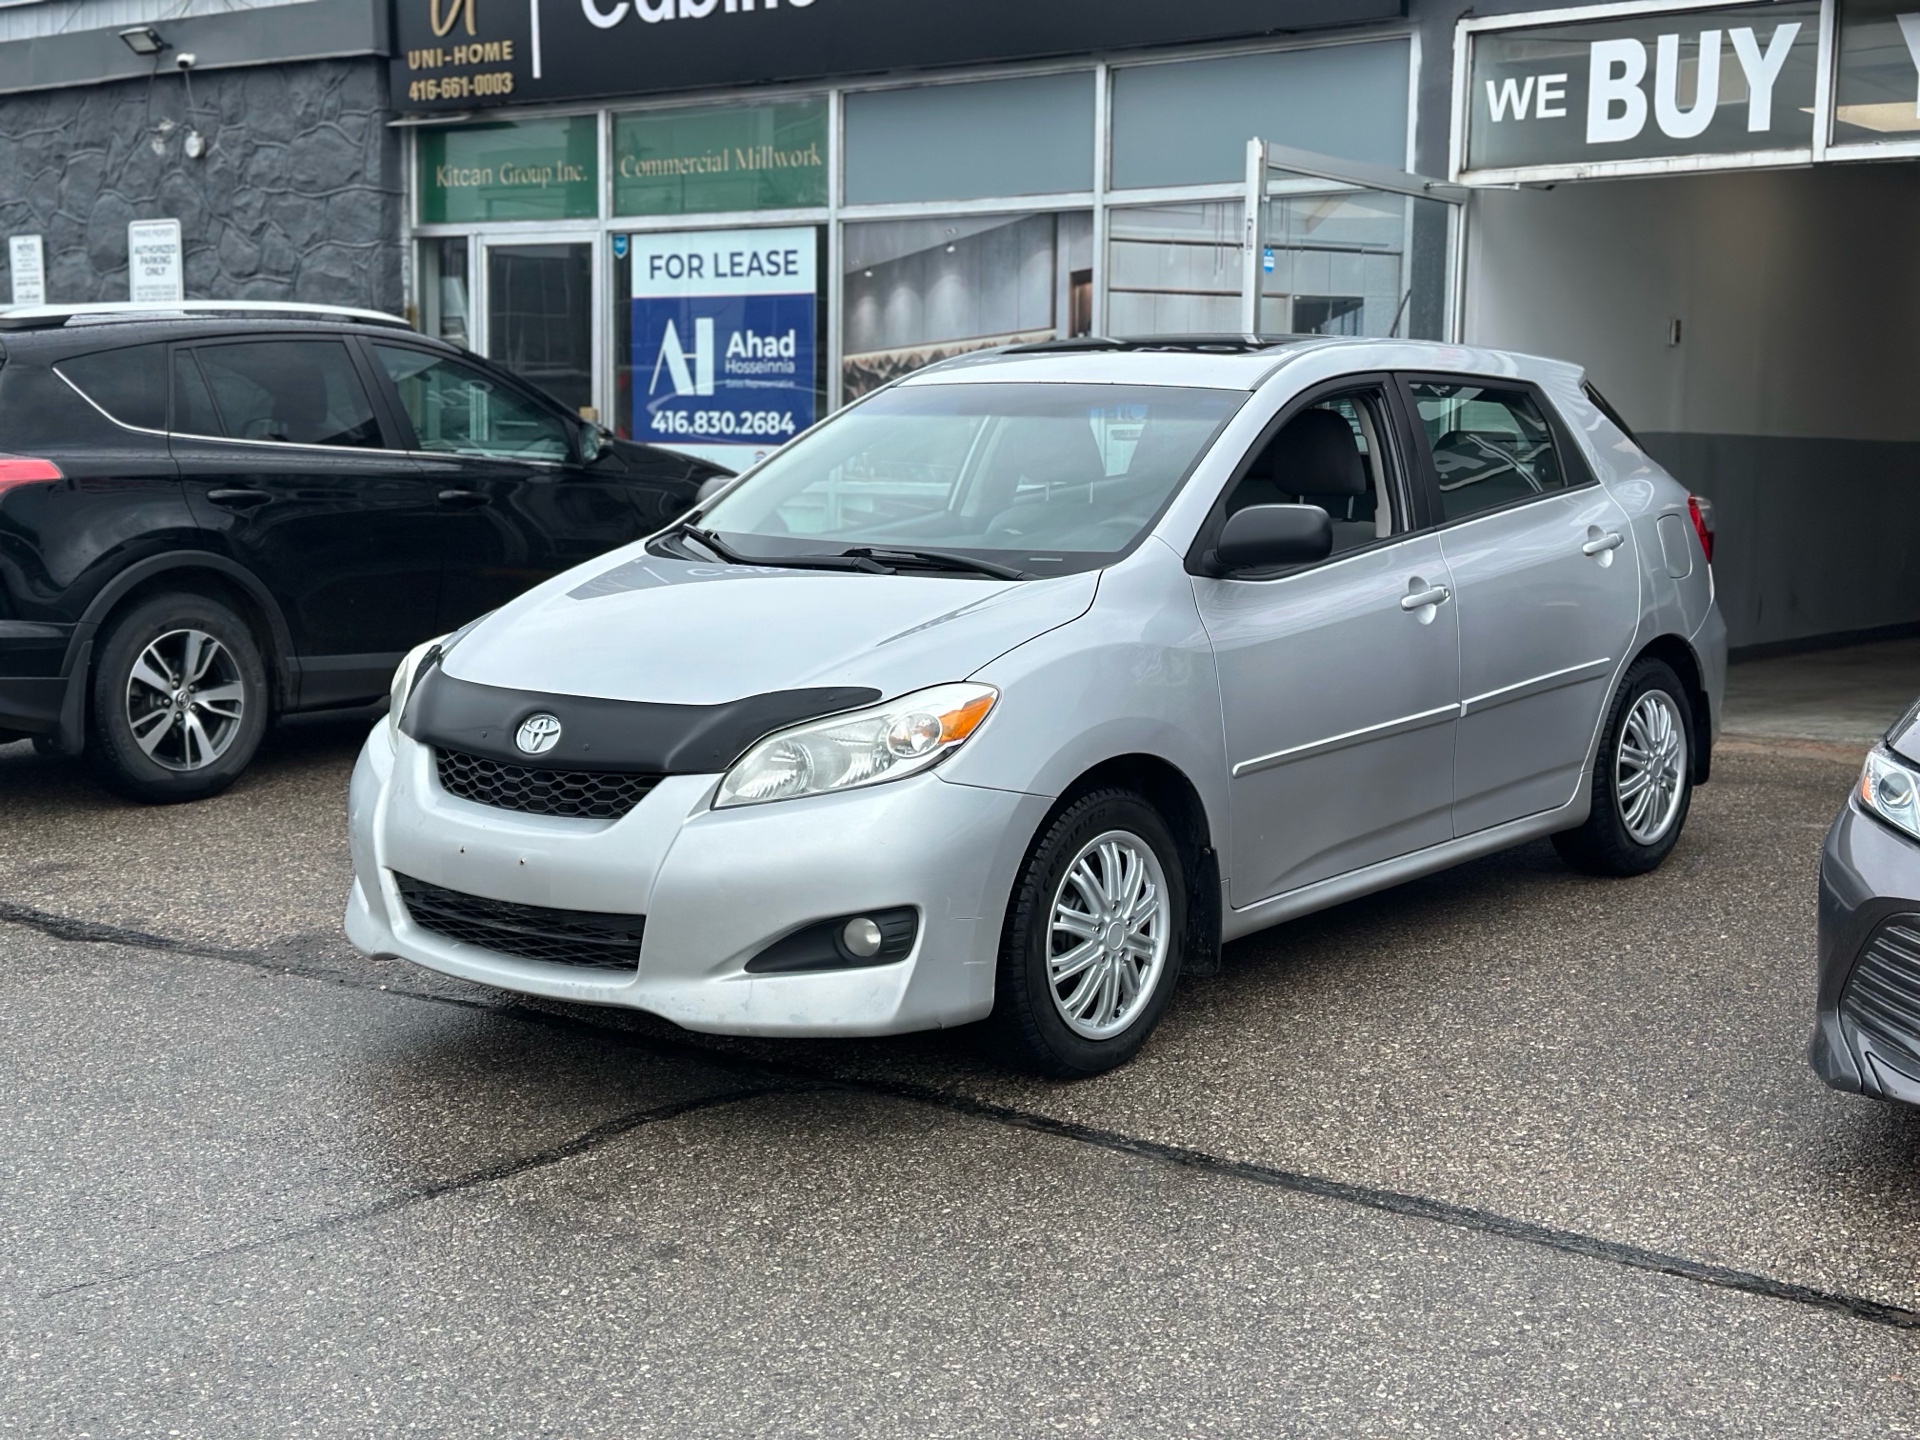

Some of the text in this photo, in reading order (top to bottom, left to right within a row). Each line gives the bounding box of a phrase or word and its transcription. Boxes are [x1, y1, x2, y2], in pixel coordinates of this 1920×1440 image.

[408, 40, 513, 70] UNI-HOME
[409, 72, 514, 101] 416-661-0003
[1486, 73, 1568, 122] WE
[1586, 22, 1802, 144] BUY
[436, 160, 588, 189] Kitcan Group Inc.
[620, 142, 822, 178] Commercial Millwork
[134, 244, 176, 254] AUTHORIZED
[140, 255, 171, 266] PARKING
[145, 266, 166, 276] ONLY
[650, 250, 799, 280] FOR LEASE
[725, 328, 796, 358] Ahad
[725, 359, 796, 374] Hosseinnia
[650, 410, 796, 435] 416.830.2684
